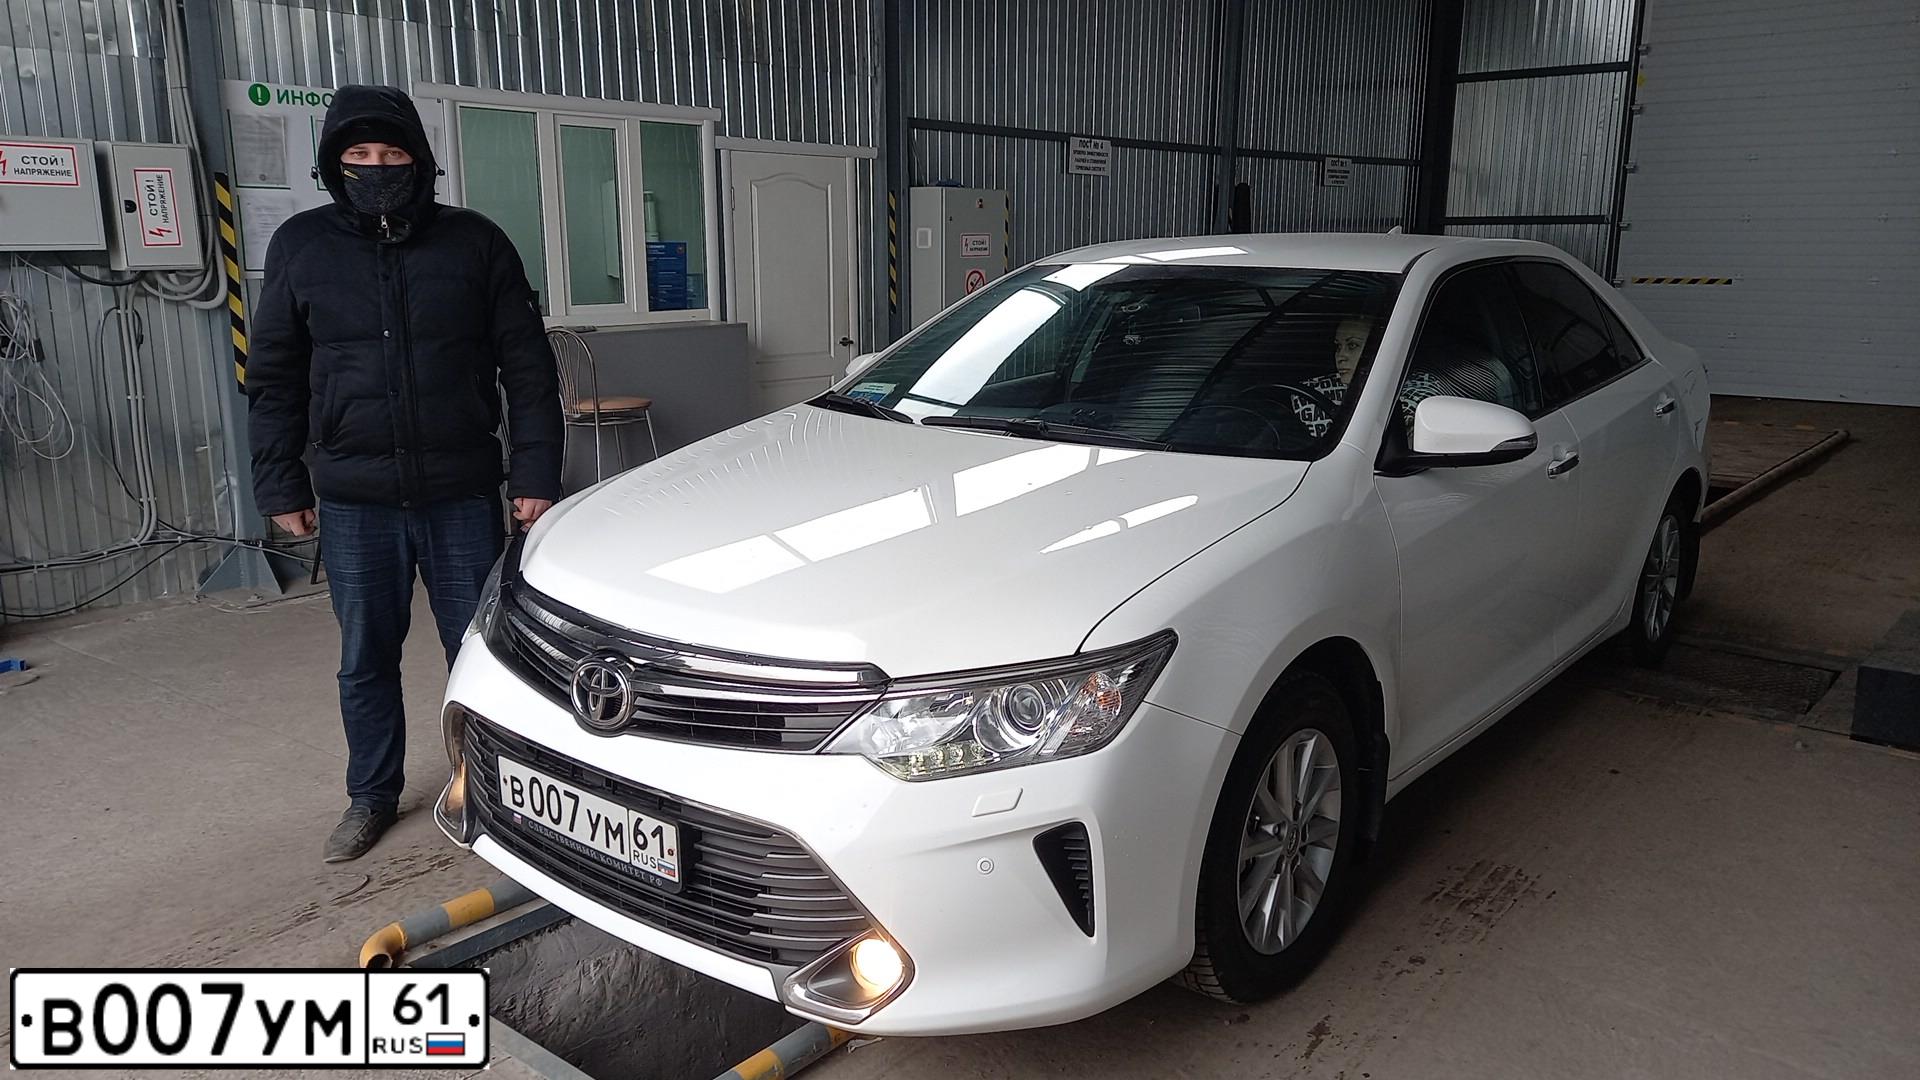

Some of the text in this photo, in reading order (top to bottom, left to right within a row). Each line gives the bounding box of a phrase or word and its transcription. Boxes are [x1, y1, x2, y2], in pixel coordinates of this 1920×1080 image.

[13, 167, 73, 177] НАПРЯЖЕНИЕ
[21, 154, 65, 167] СТОЙ!
[144, 179, 159, 217] СТОЙ!
[155, 173, 170, 224] НАПРЯЖЕНИЕ
[528, 820, 663, 887] СЛЕДСТВЕННЫЙ КОМИТЕТ РФ
[633, 817, 665, 858] 61
[633, 850, 657, 869] RUS
